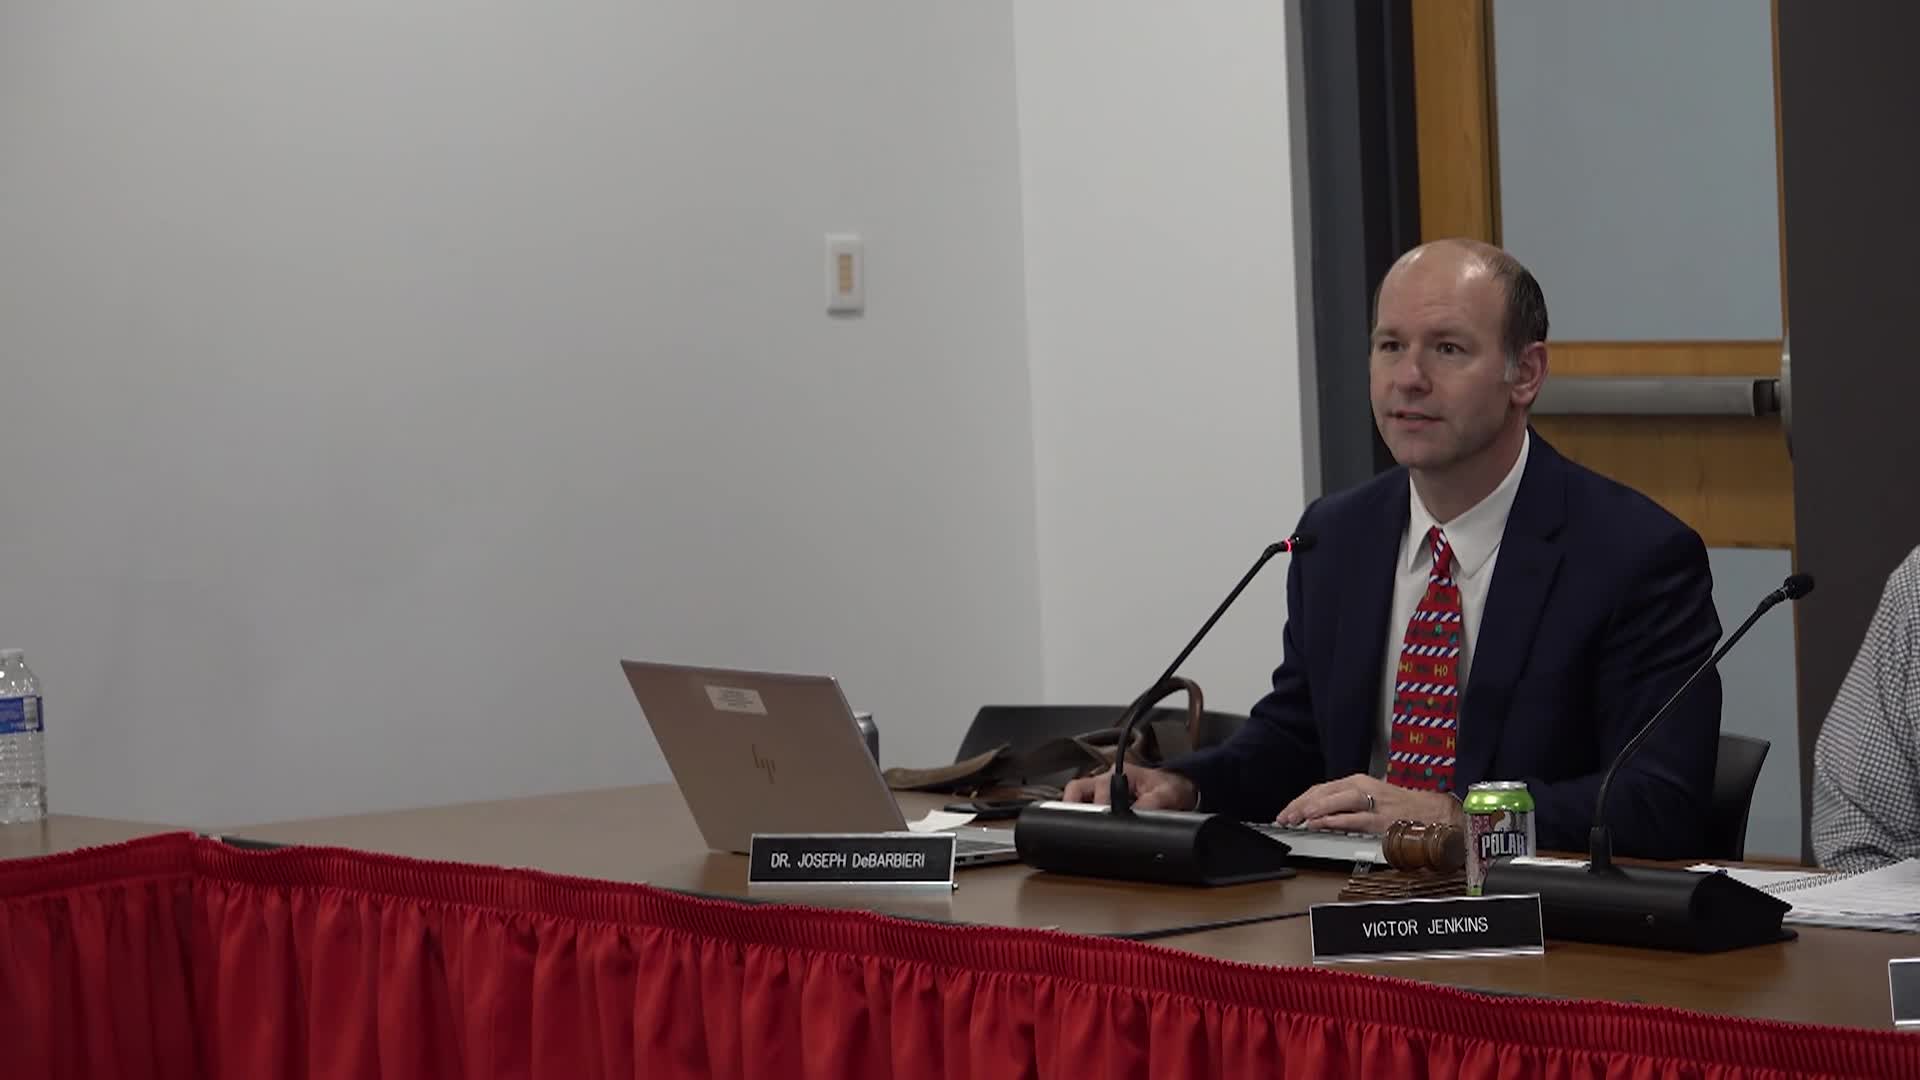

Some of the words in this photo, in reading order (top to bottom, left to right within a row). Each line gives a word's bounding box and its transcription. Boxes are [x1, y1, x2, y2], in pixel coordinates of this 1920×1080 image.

[1481, 832, 1528, 859] POLAR
[770, 853, 791, 868] DR.
[797, 853, 846, 868] JOSEPH
[852, 853, 925, 868] DeBARBIERI
[1362, 919, 1418, 938] VICTOR
[1428, 917, 1488, 934] JENKINS
